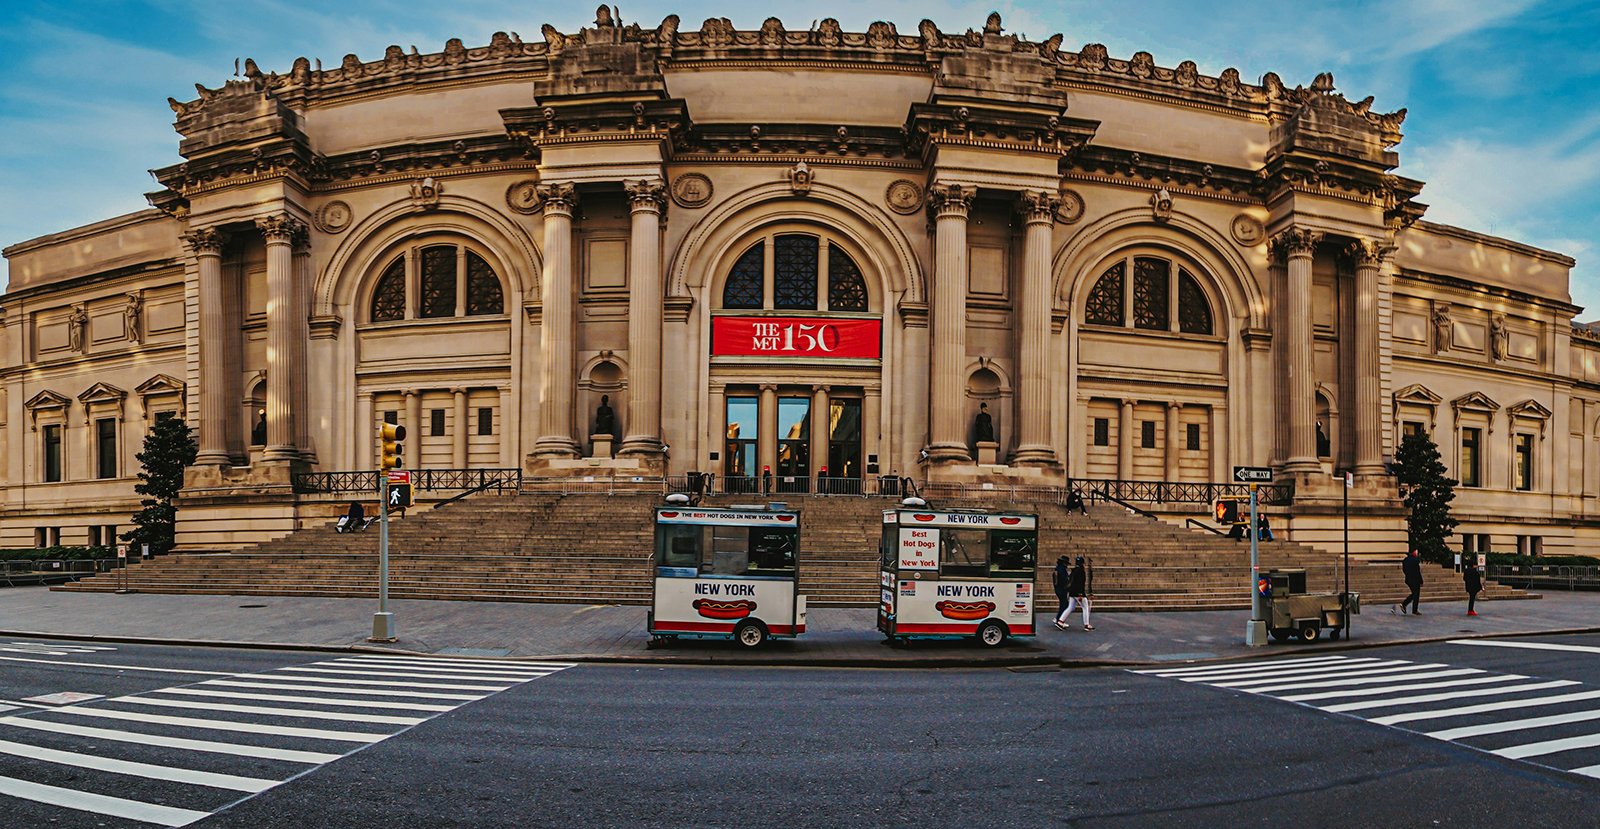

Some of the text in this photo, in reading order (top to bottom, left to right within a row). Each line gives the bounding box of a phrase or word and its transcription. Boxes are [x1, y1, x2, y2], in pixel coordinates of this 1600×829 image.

[752, 322, 780, 337] THE
[780, 323, 840, 352] 150
[752, 336, 781, 351] MET
[1240, 470, 1268, 479] ONE WAY
[947, 514, 989, 524] NEW YORK
[911, 530, 927, 538] Best
[917, 540, 936, 549] Dogs
[901, 559, 918, 567] New
[694, 583, 756, 596] NEW YORK
[937, 585, 995, 598] NEW YORK
